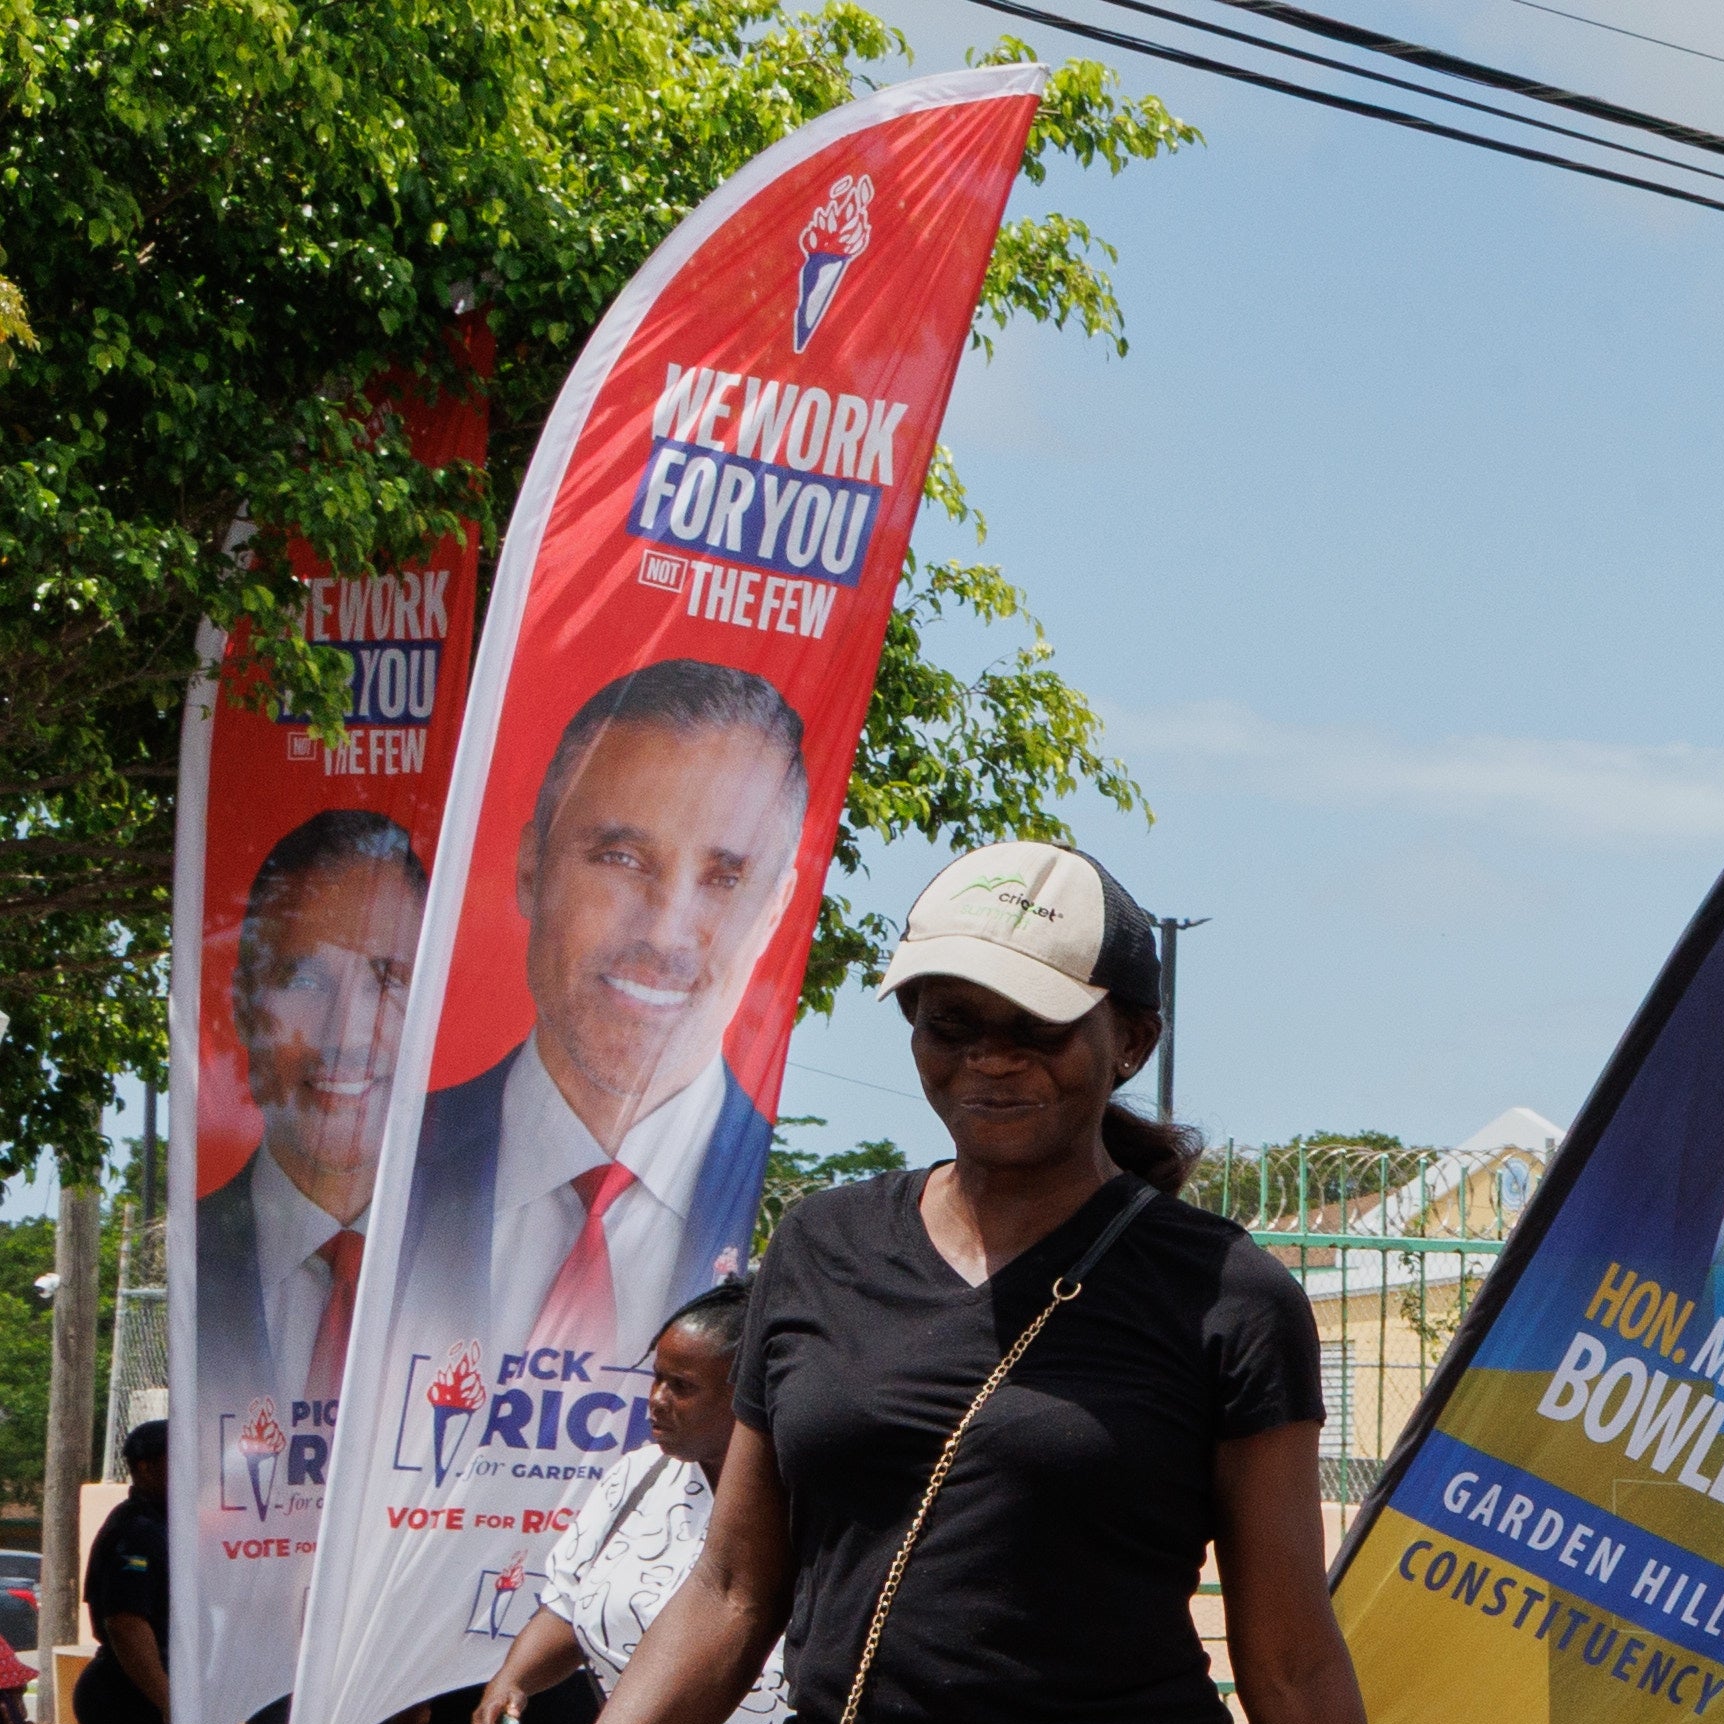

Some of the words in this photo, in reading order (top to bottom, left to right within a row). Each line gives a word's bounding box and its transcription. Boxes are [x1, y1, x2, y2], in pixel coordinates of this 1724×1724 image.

[652, 362, 742, 451] WE
[737, 376, 909, 486] WORK
[639, 447, 756, 552] FOR
[758, 473, 871, 575] YOU
[339, 570, 450, 642] WORK
[647, 557, 680, 586] NOT
[687, 560, 762, 628] THE
[757, 577, 838, 640] FEW
[358, 648, 437, 718] YOU
[368, 729, 427, 775] FEW
[1585, 1261, 1696, 1364] HON.
[496, 1347, 597, 1385] PICK
[291, 1399, 341, 1428] PIC
[461, 1455, 506, 1482] for
[511, 1463, 604, 1481] GARDEN
[222, 1537, 291, 1560] VOTE
[387, 1506, 465, 1531] VOTE
[474, 1513, 516, 1529] FOR
[521, 1508, 581, 1534] RIC
[1443, 1471, 1627, 1585] GARDEN
